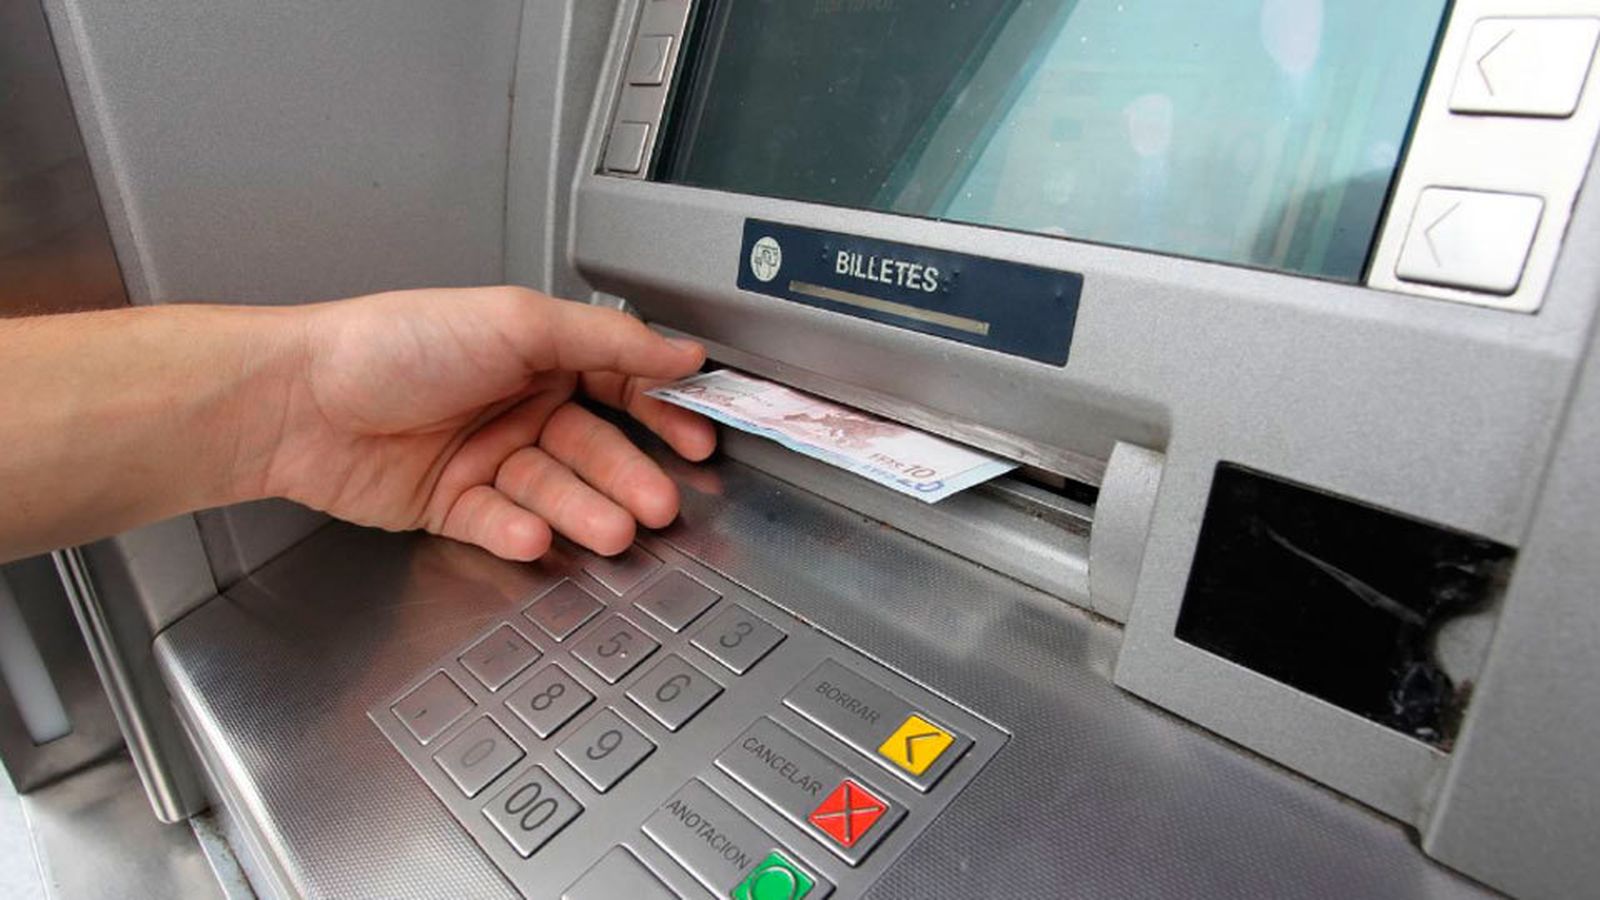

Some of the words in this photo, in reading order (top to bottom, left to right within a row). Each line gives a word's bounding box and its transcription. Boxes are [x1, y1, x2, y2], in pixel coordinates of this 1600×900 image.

[835, 250, 939, 292] BILLETES
[903, 465, 936, 478] 10
[598, 631, 632, 657] 5
[720, 622, 753, 648] 3
[531, 683, 565, 711] 8
[656, 673, 691, 702] 6
[815, 681, 880, 725] BORRAR
[461, 739, 496, 768] 0
[586, 730, 623, 760] 9
[742, 737, 823, 796] CANCELAR
[505, 782, 558, 831] 00
[666, 799, 752, 870] ANOTACION
